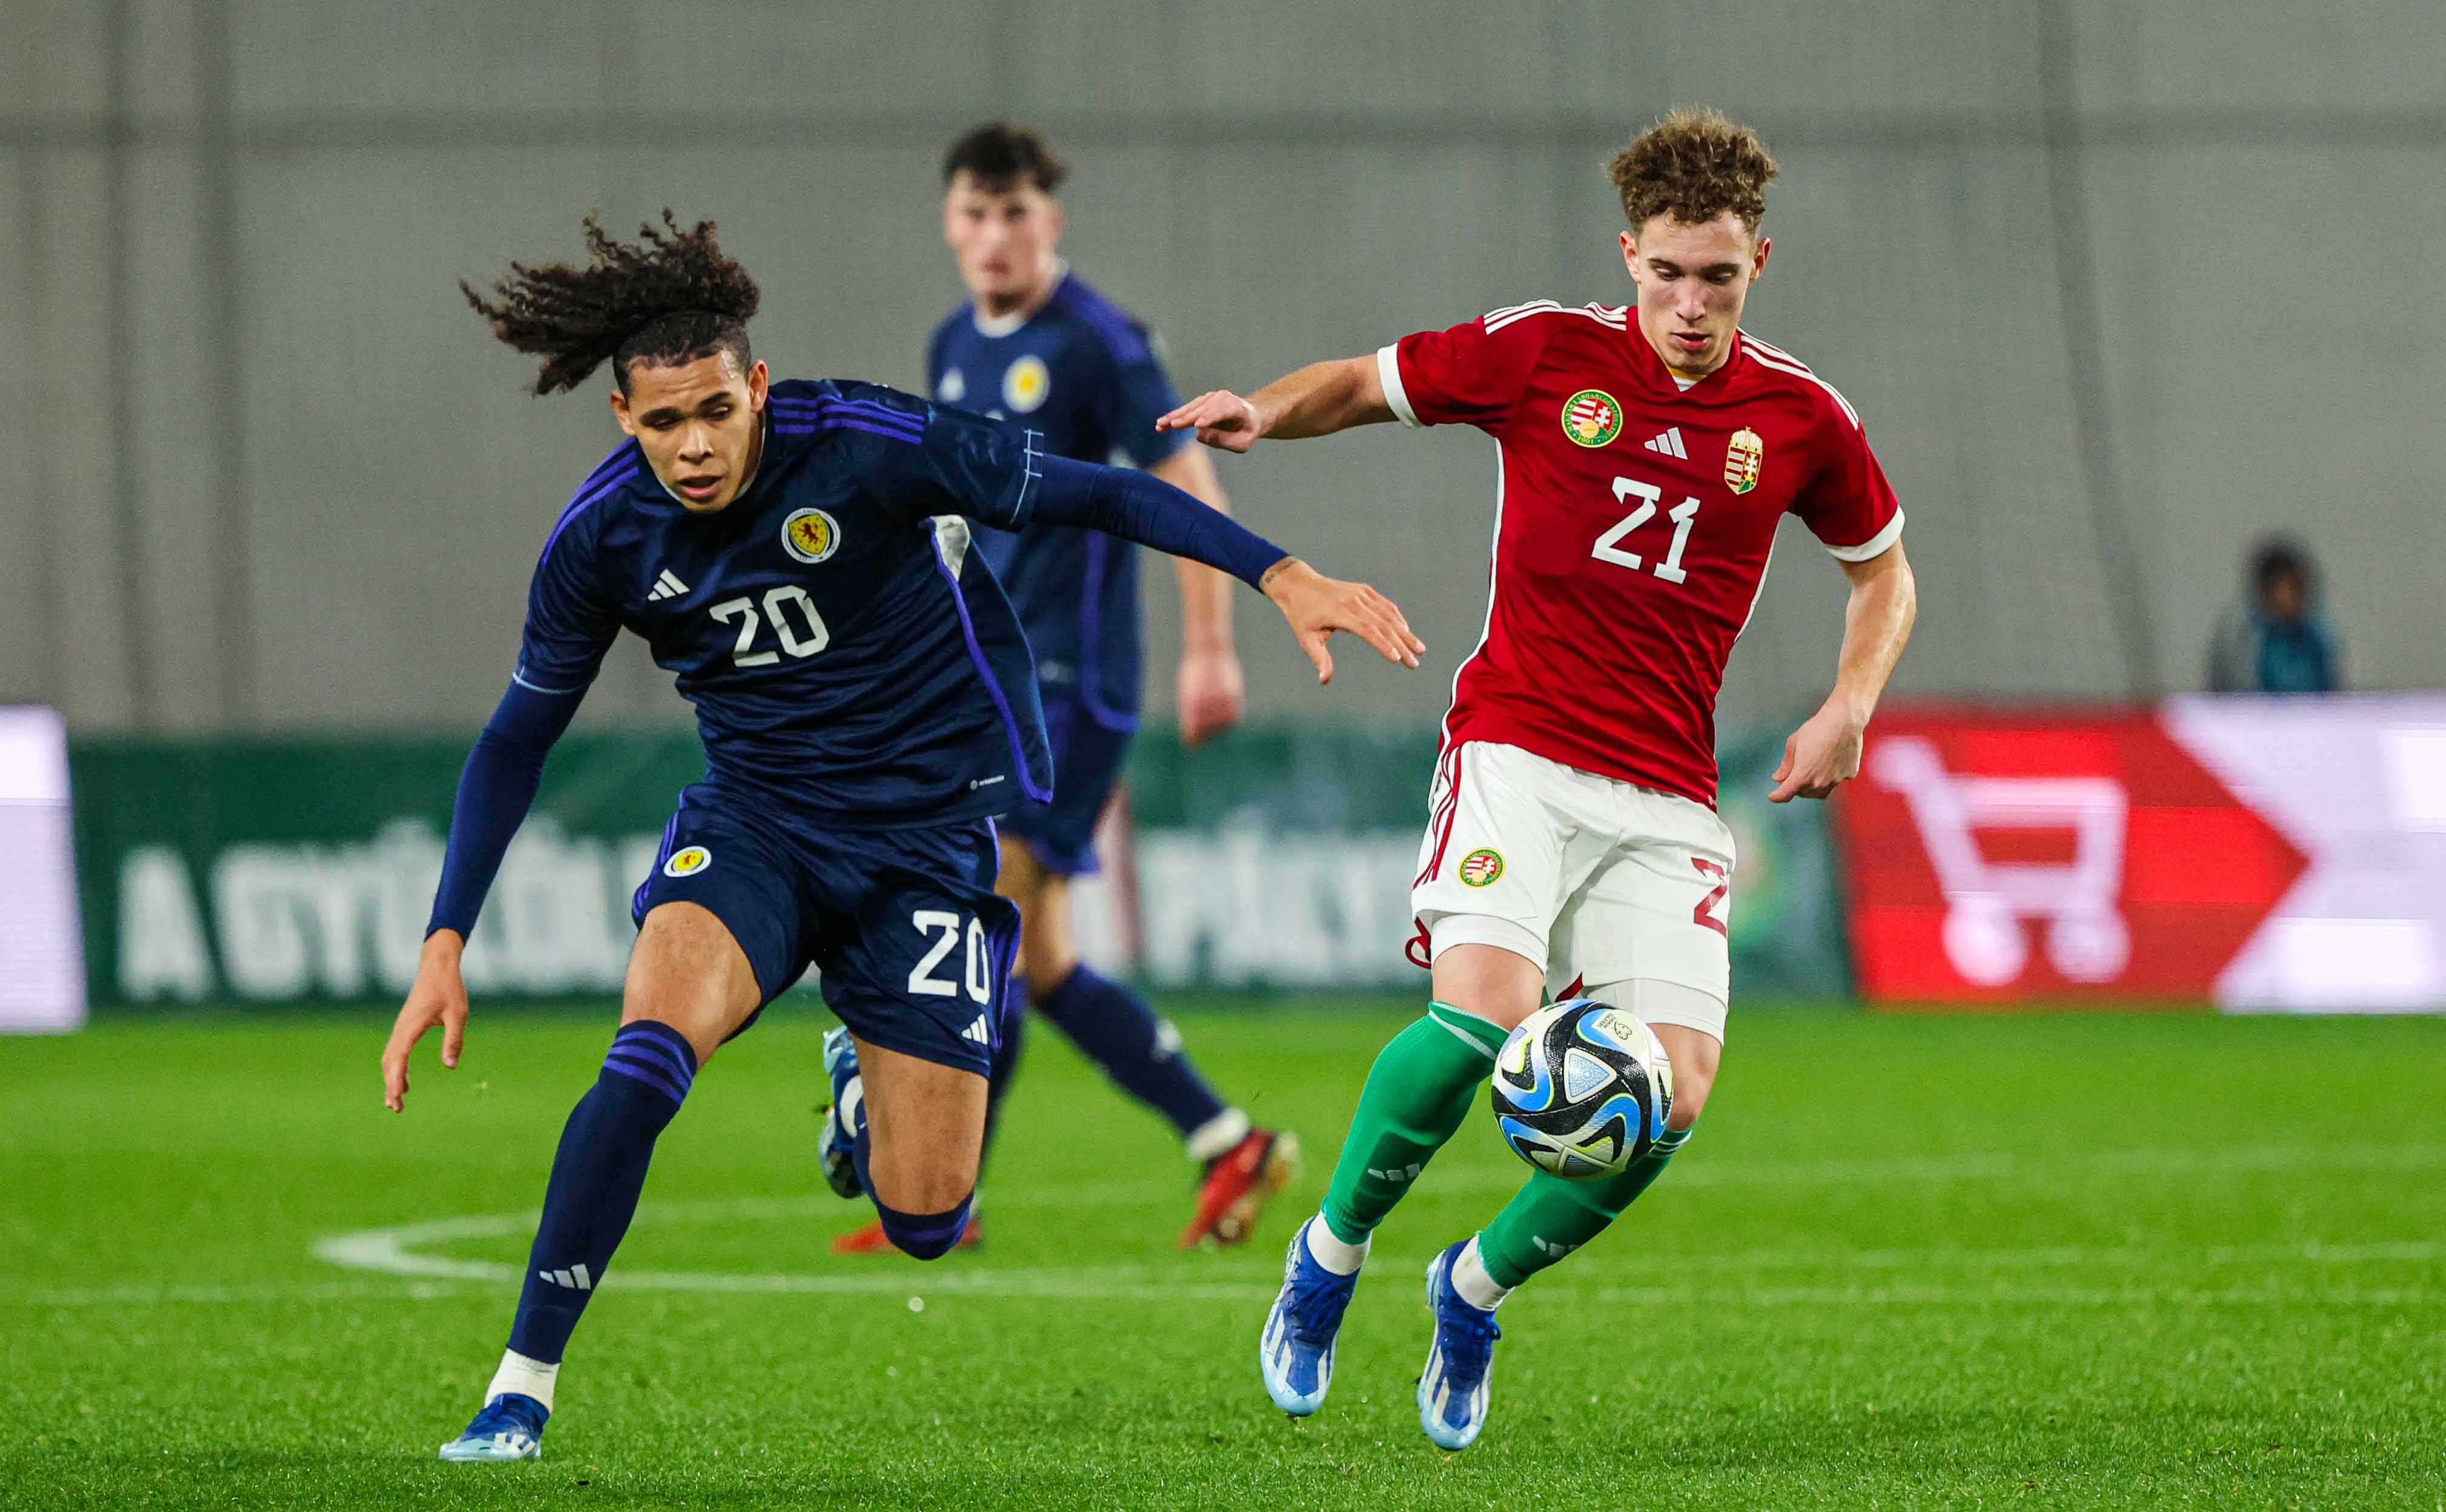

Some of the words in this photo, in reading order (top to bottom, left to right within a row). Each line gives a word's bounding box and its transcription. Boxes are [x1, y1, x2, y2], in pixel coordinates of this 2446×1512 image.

[1591, 476, 1700, 584] 21
[709, 585, 830, 667] 20
[119, 845, 213, 1001] A
[909, 910, 990, 1006] 20
